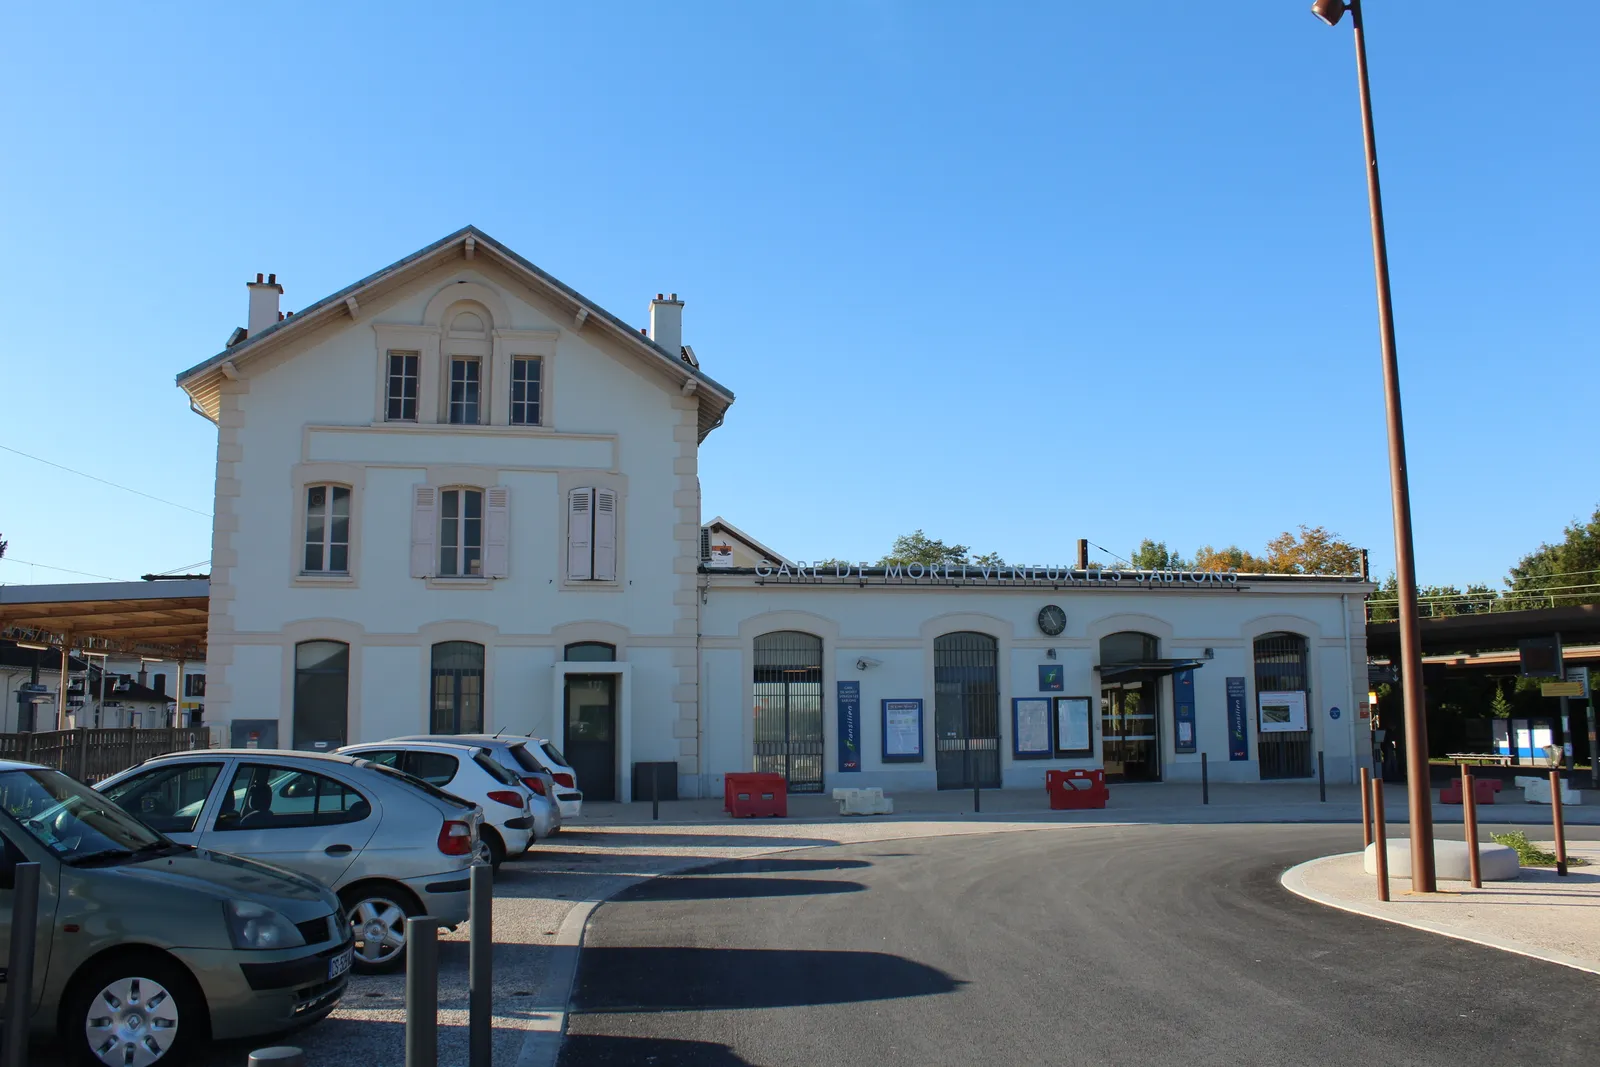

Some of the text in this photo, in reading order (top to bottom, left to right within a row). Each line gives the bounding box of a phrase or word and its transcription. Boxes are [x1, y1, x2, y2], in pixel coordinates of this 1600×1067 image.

[755, 560, 822, 579] GARE
[837, 561, 869, 579] DE
[1135, 565, 1238, 584] SABLONS
[846, 705, 854, 747] Transilien
